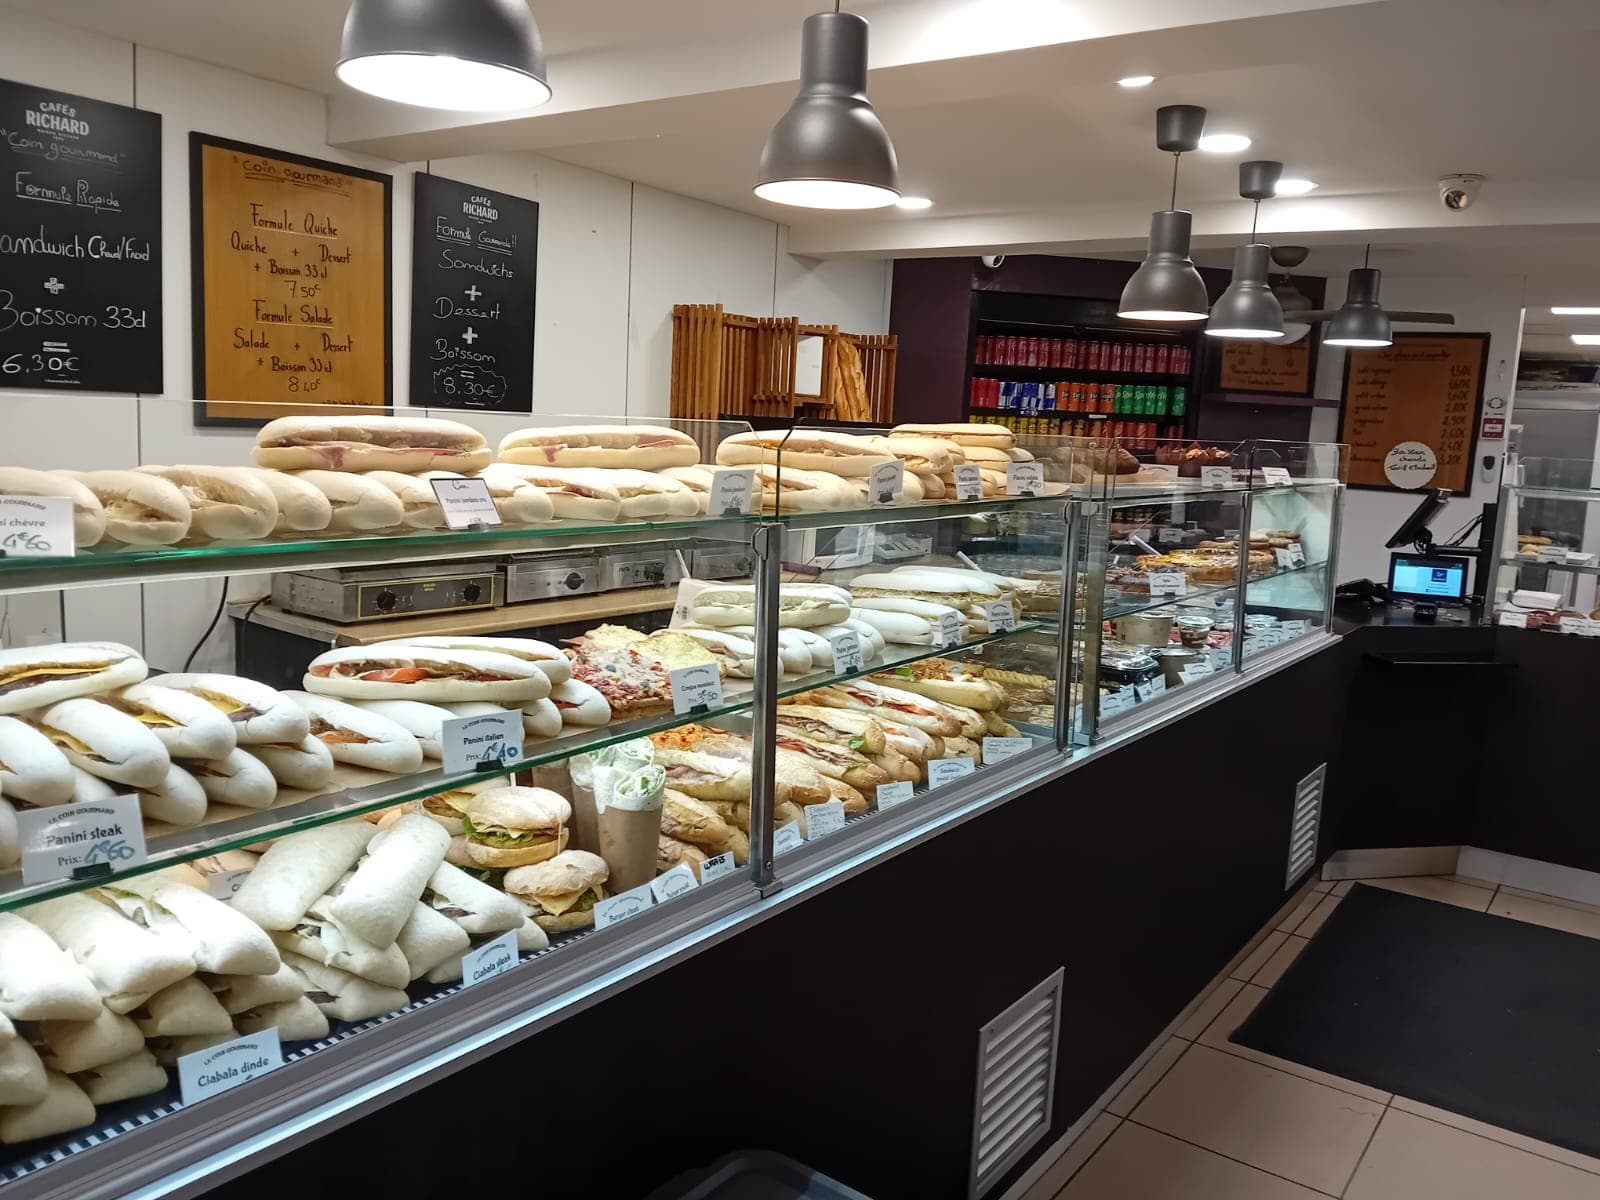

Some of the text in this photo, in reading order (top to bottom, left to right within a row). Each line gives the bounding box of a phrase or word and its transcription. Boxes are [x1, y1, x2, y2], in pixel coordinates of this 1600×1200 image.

[40, 102, 76, 117] CAFÉS
[26, 110, 90, 136] RICHARD
[16, 171, 121, 214] Formule Rapide
[250, 202, 339, 236] Formule Quiche
[463, 202, 499, 221] RICHARD
[0, 224, 85, 258] andwich
[230, 230, 268, 255] Quiche
[318, 243, 353, 265] Dessert
[438, 249, 514, 279] Sandwichs
[252, 298, 334, 325] Formule Salade
[432, 296, 501, 320] Dessert
[233, 327, 270, 350] Salade
[321, 333, 354, 353] Dessert
[9, 518, 46, 527] chèvre
[463, 737, 484, 745] Panini
[46, 824, 123, 848] Panini steak
[58, 856, 83, 867] Prix:
[240, 1056, 270, 1074] dinde
